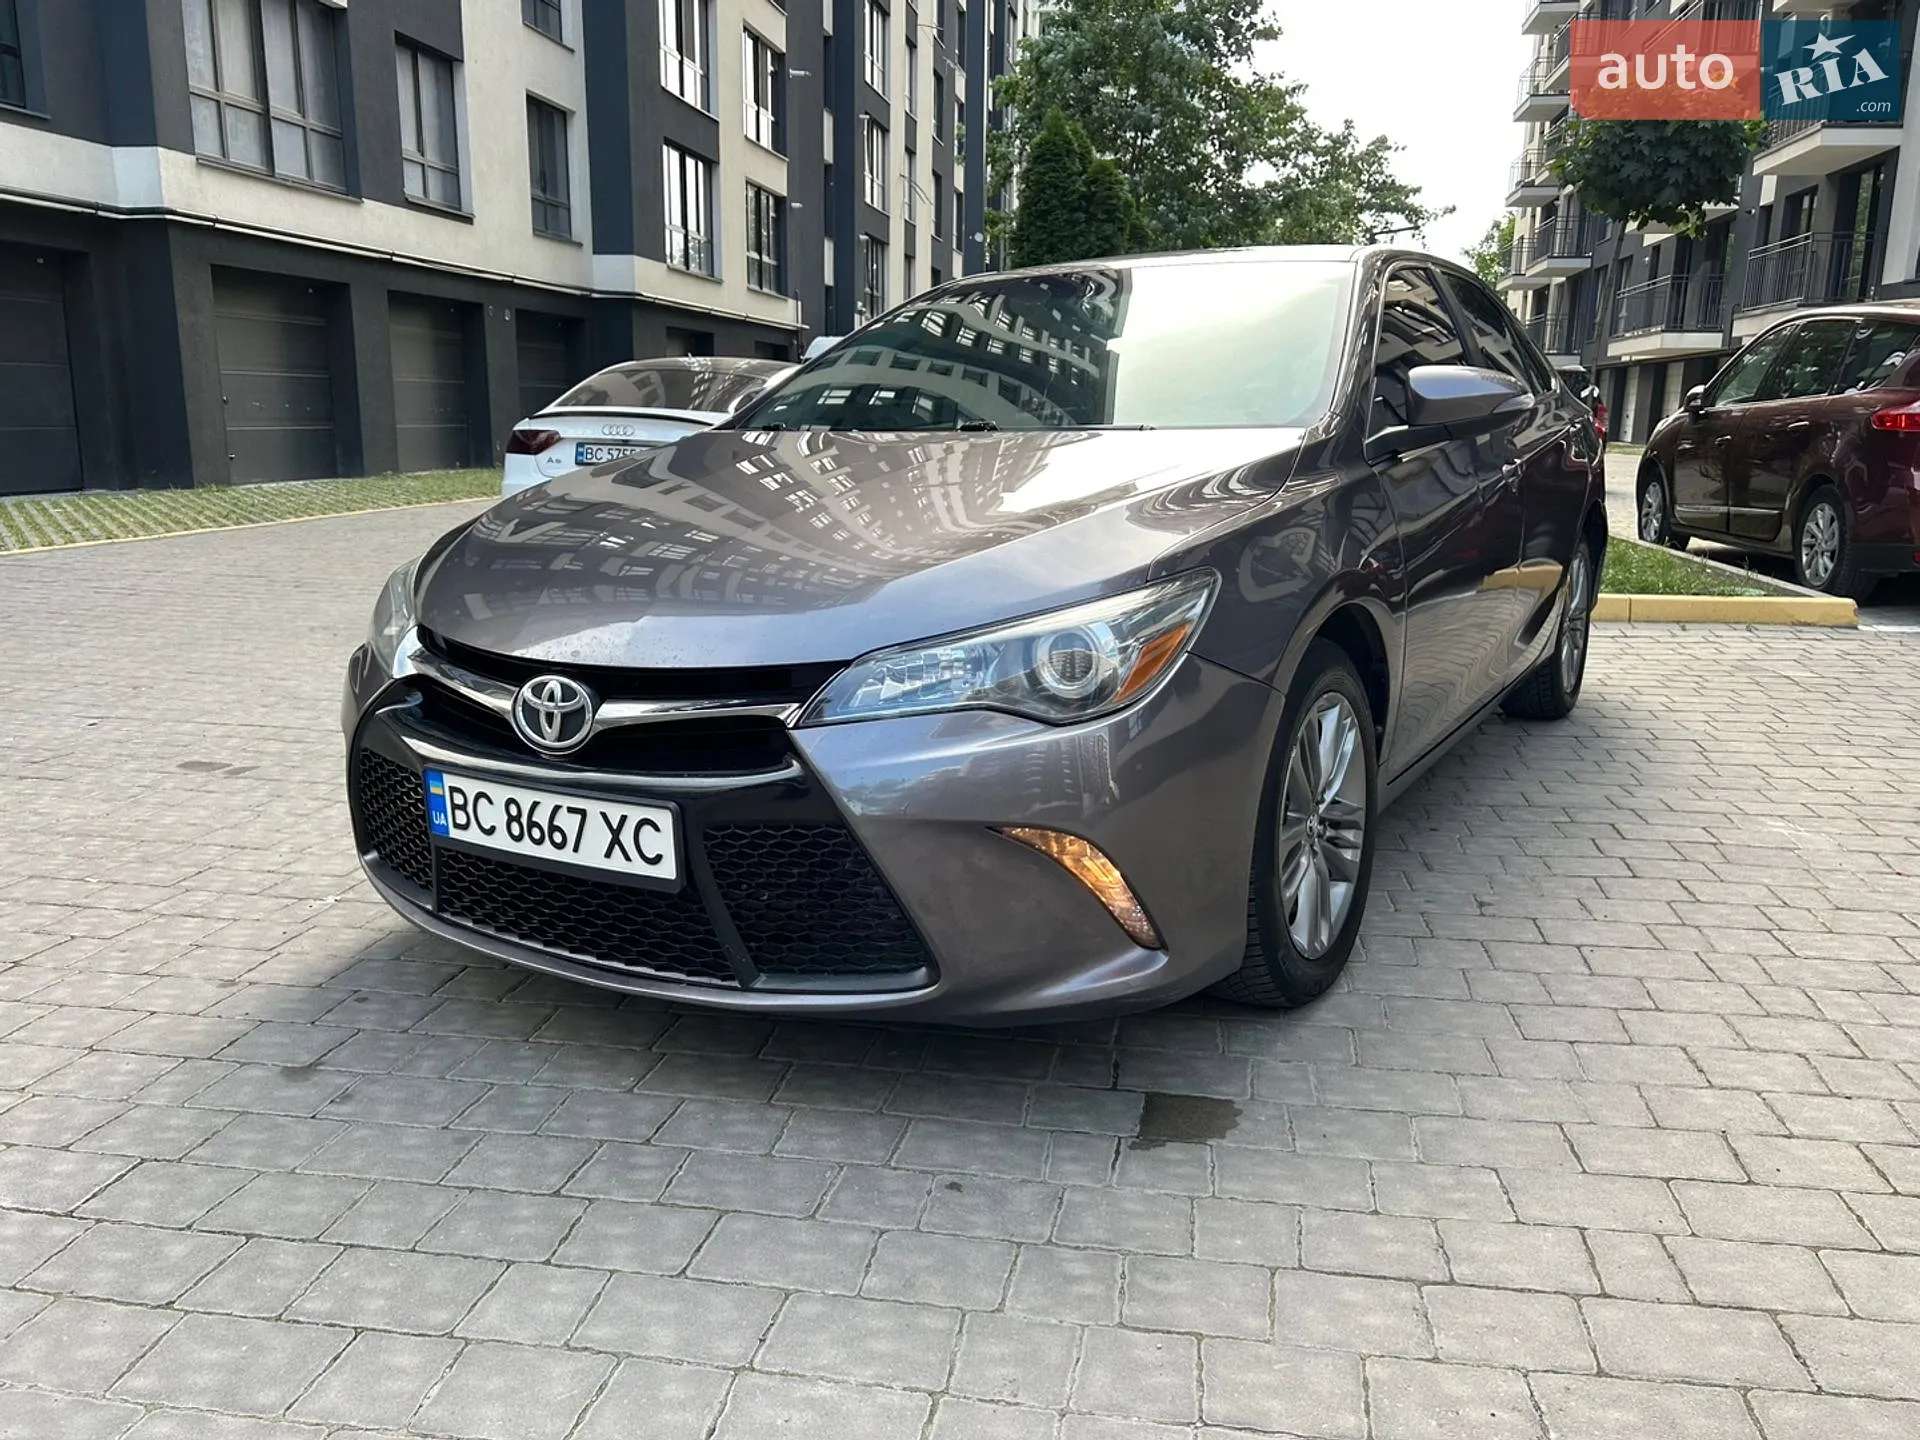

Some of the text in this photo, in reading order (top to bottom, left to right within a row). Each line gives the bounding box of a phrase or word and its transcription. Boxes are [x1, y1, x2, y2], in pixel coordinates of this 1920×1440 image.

[585, 447, 603, 461] BC
[433, 810, 447, 827] UA
[448, 785, 664, 865] BC 8667 XC
